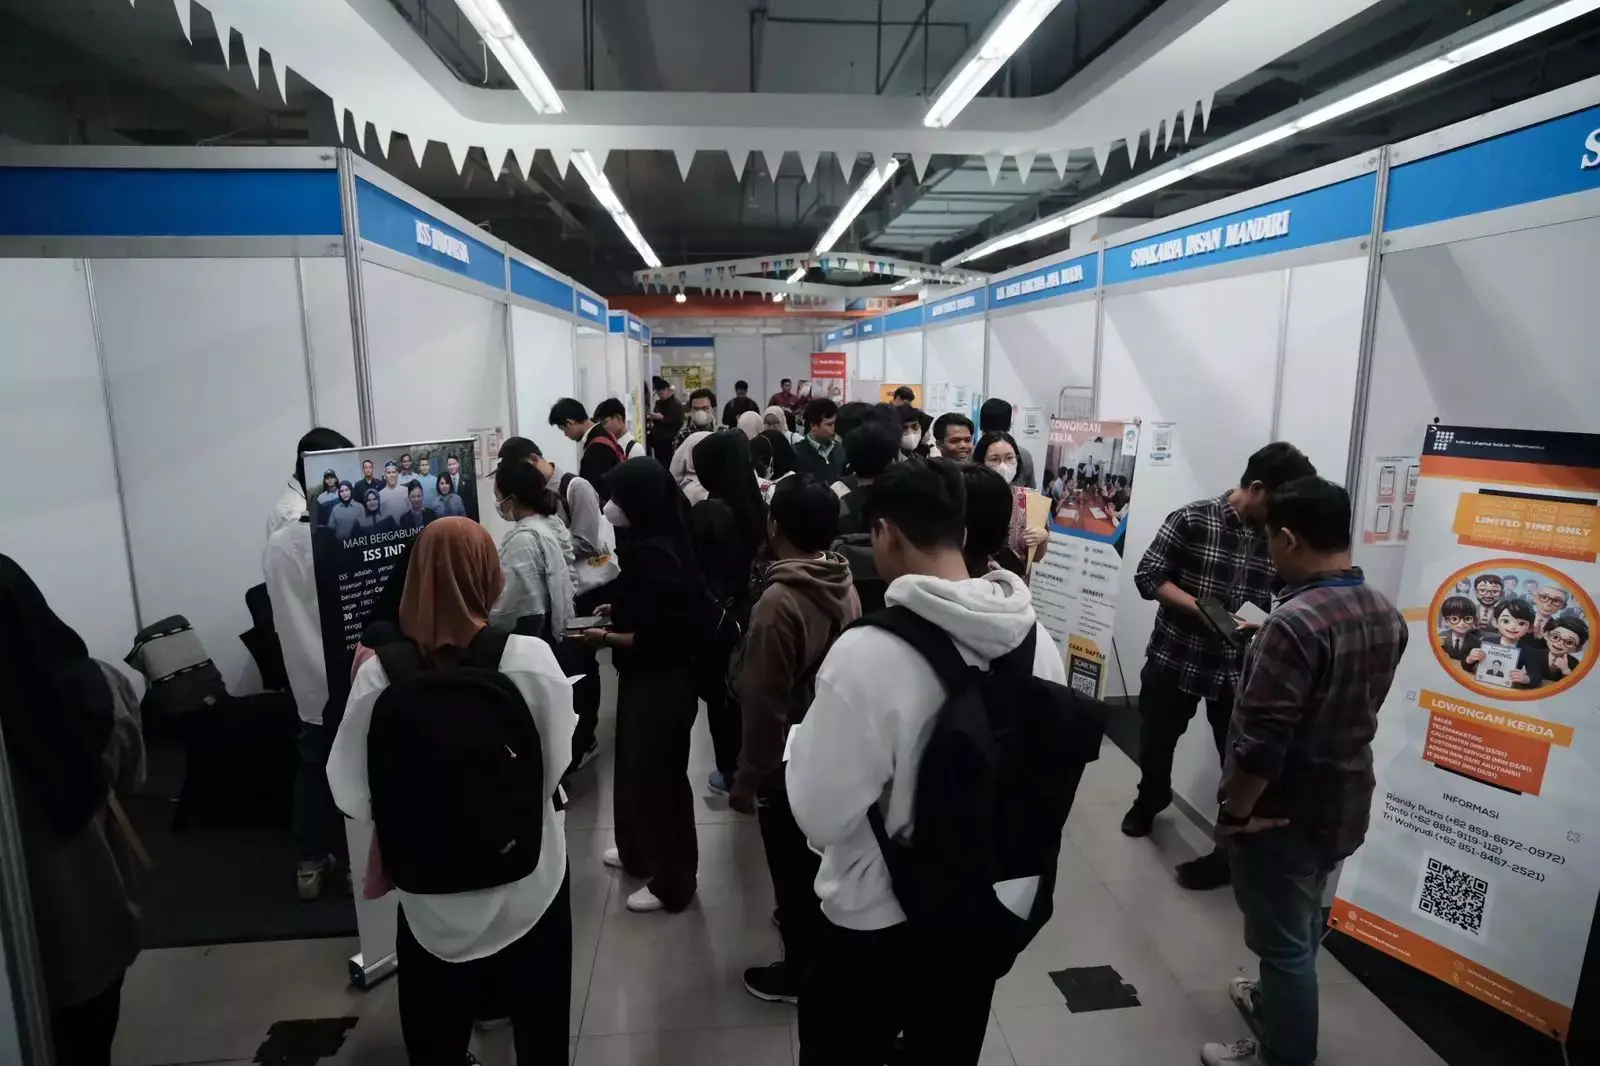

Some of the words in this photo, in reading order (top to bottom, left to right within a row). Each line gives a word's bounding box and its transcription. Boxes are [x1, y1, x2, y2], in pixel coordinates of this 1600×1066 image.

[1130, 239, 1183, 268] SWAKARYA
[1185, 228, 1222, 256] INSAN
[1225, 210, 1291, 247] MANDIRI
[1050, 419, 1102, 433] LOWONGAN
[1049, 432, 1073, 443] KERJA
[1475, 516, 1521, 529] LIMITED
[1524, 521, 1554, 532] TIME
[1556, 526, 1592, 537] ONLY
[343, 535, 369, 550] MARI
[363, 548, 382, 562] ISS
[353, 568, 373, 578] adalah
[340, 591, 362, 601] berasal
[1082, 587, 1104, 598] BENEFIT
[341, 602, 357, 611] sejak
[343, 612, 353, 621] 30
[1069, 642, 1084, 652] CARA
[1073, 658, 1089, 668] SCAN
[1431, 698, 1505, 725] LOWONGAN
[1507, 717, 1555, 738] KERJA
[1433, 716, 1453, 726] SALES
[1431, 730, 1469, 747] CALLCENTER
[1432, 723, 1483, 743] TELEMARKETING
[1428, 744, 1449, 756] ADMIN
[1429, 737, 1462, 751] CUSTOMER
[1463, 748, 1491, 761] SERVICE
[1433, 754, 1461, 767] SUPPORT
[1442, 792, 1500, 820] INFORMASI
[1384, 801, 1409, 817] Tanto
[1410, 811, 1431, 826] (+62
[1432, 820, 1503, 856] 888-9119-112)
[1386, 792, 1416, 810] Riandy
[1418, 803, 1444, 820] Putra
[1445, 814, 1467, 829] (+62
[1468, 824, 1566, 865] 859-6672-0972)
[1382, 811, 1393, 821] Tri
[1394, 816, 1434, 838] Wahyudi
[1435, 832, 1457, 847] (+62
[1458, 841, 1545, 883] 851-8457-2521)
